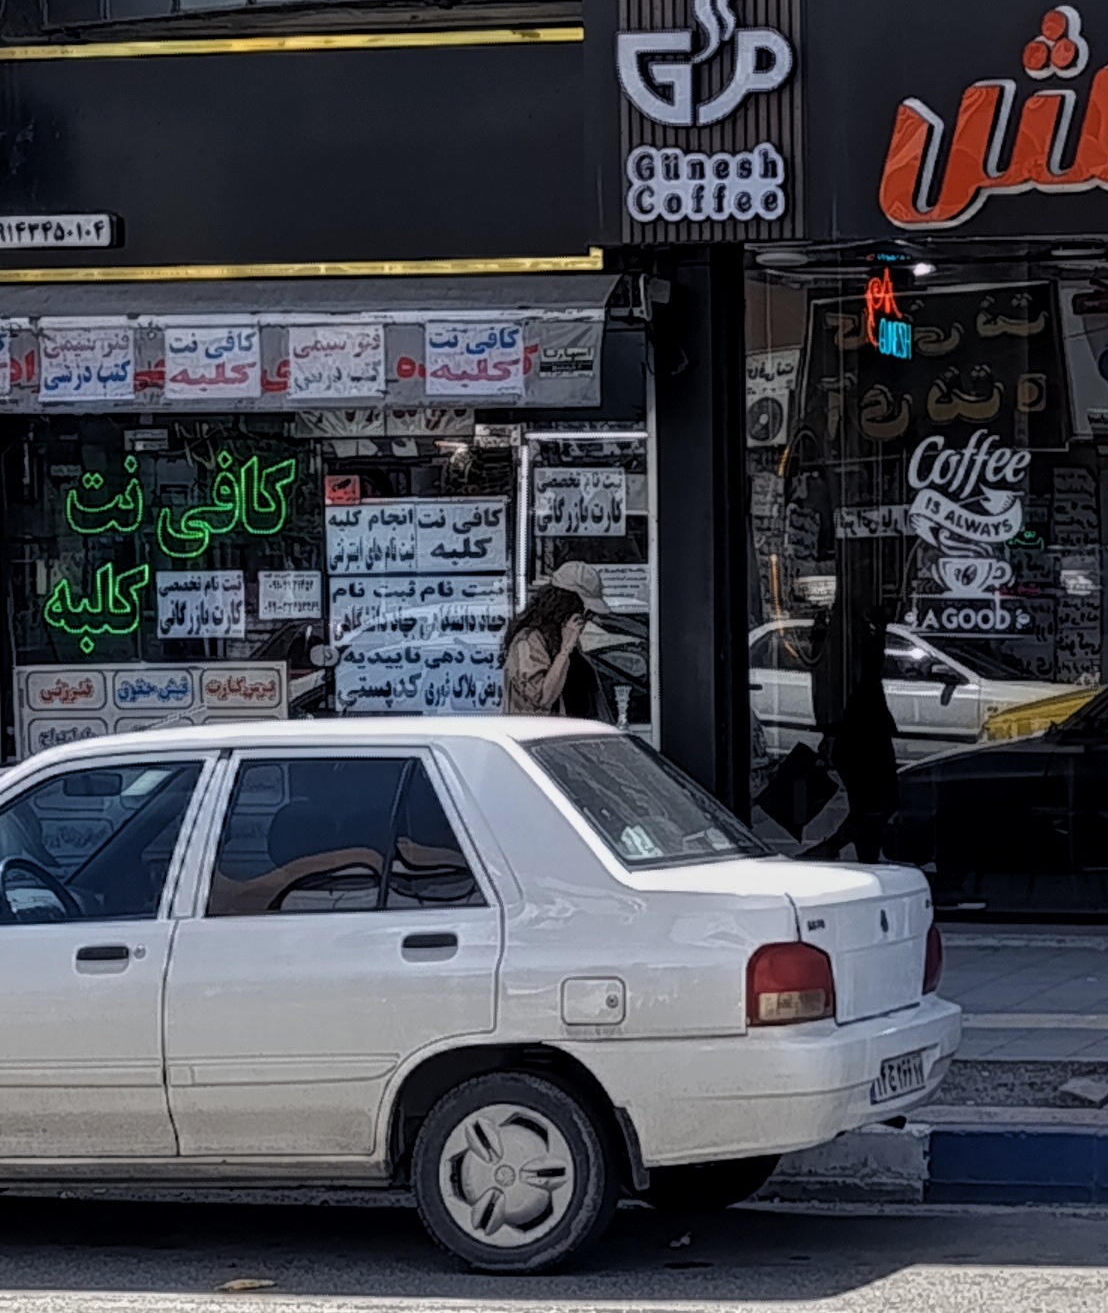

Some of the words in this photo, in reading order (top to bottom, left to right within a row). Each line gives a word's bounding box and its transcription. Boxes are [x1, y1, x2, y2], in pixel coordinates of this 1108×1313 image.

[631, 147, 782, 184] Günesh
[631, 183, 782, 217] Coffee
[169, 332, 198, 354] نت
[204, 330, 257, 359] کافی
[428, 328, 458, 350] نت
[466, 326, 520, 355] کافی
[169, 361, 257, 392] کلبه
[430, 358, 521, 388] کلبه
[907, 428, 1032, 499] Coffee
[66, 454, 144, 534] نت
[157, 450, 296, 559] کافی
[367, 508, 414, 532] انجام
[417, 508, 447, 529] نت
[452, 506, 503, 535] کافی
[924, 495, 942, 516] IS
[943, 510, 1014, 538] ALWAYS
[430, 536, 493, 566] کلبه
[332, 581, 366, 603] نام
[43, 561, 150, 654] کلبه
[922, 609, 940, 629] A
[941, 608, 1011, 630] GOOD
